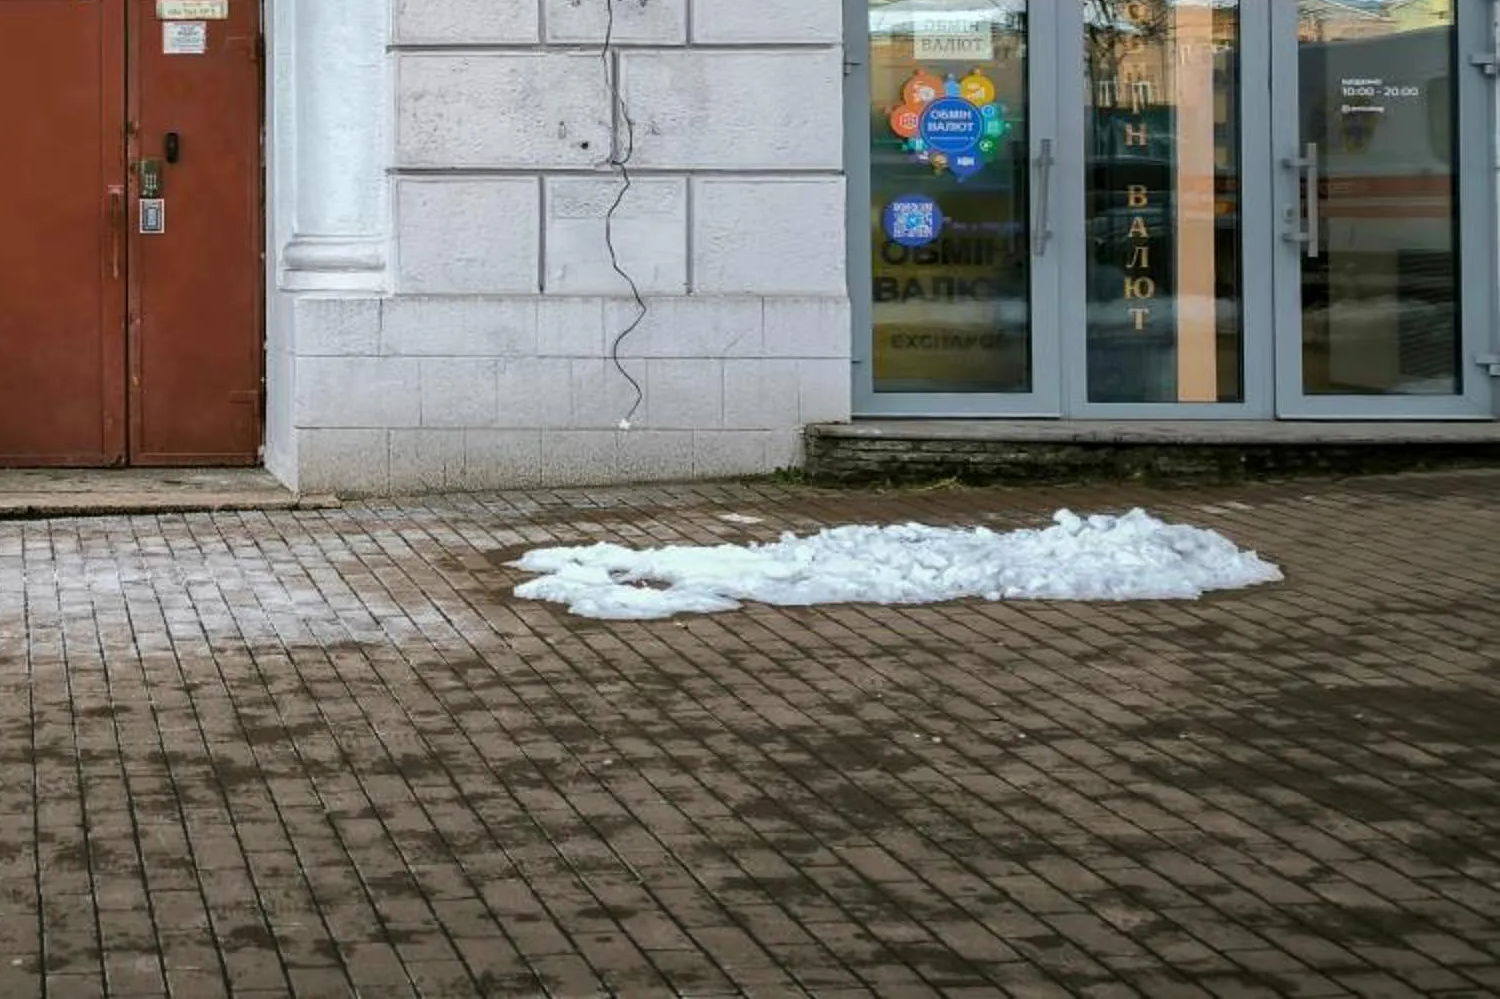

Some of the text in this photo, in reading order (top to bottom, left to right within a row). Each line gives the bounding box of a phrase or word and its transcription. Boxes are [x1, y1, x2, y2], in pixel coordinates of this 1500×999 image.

[921, 38, 984, 51] ВАЛЮТ
[930, 109, 973, 120] ОБМІН
[927, 121, 975, 132] ВАЛЮТ
[1123, 184, 1155, 330] ВАЛЮТ
